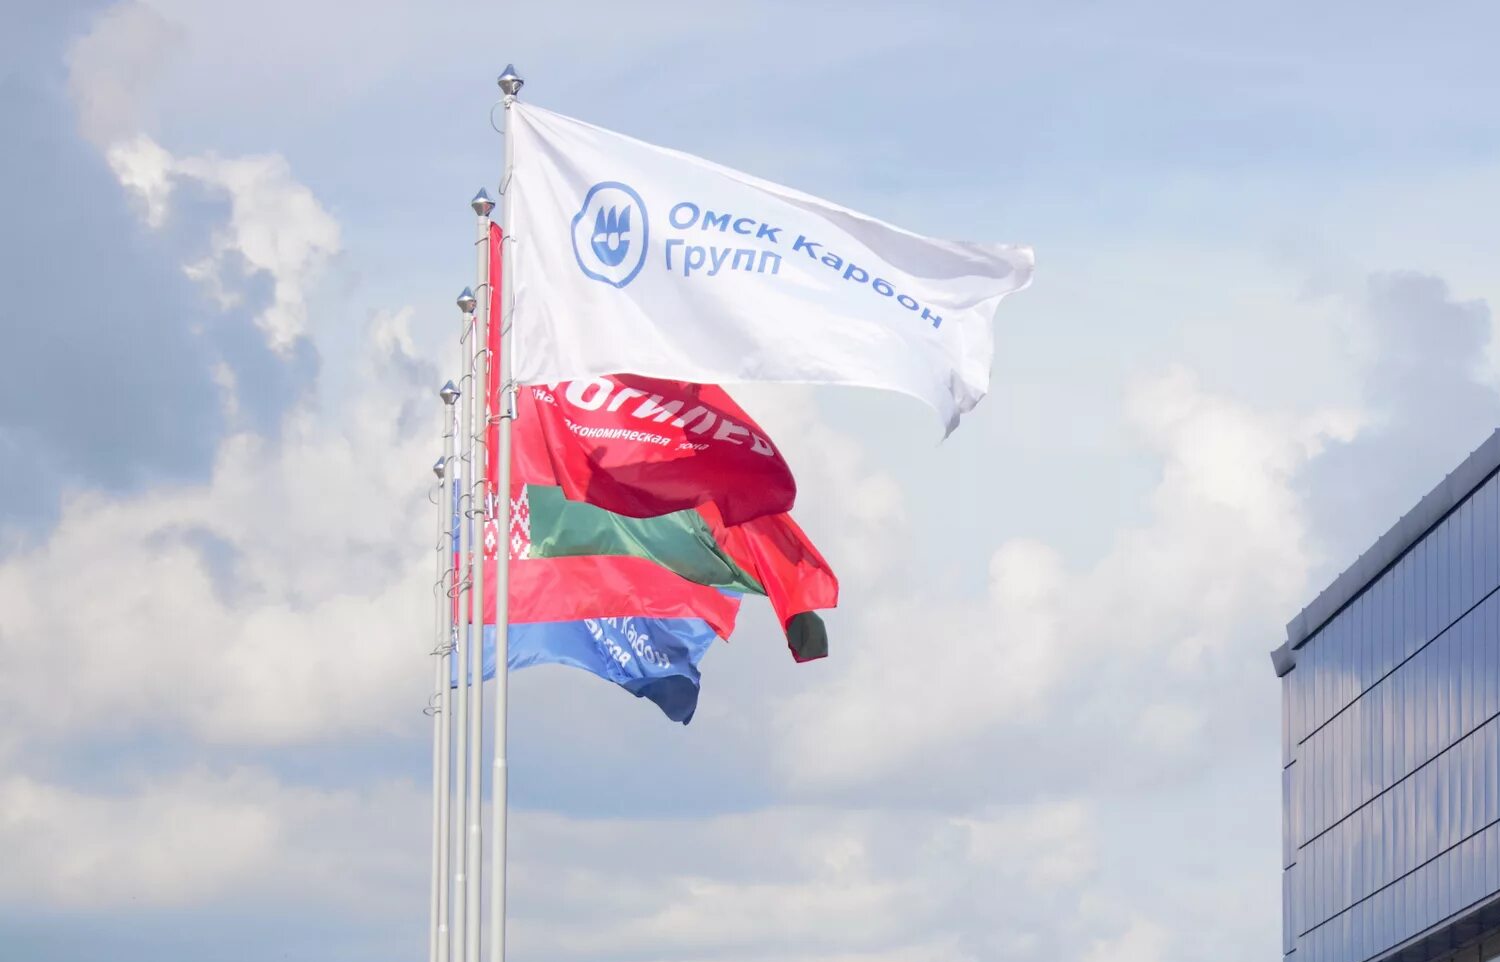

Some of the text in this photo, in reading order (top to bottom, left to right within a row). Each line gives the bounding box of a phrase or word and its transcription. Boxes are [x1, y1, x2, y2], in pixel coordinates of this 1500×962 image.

[665, 239, 782, 277] Групп
[669, 202, 943, 329] Омск Карбон
